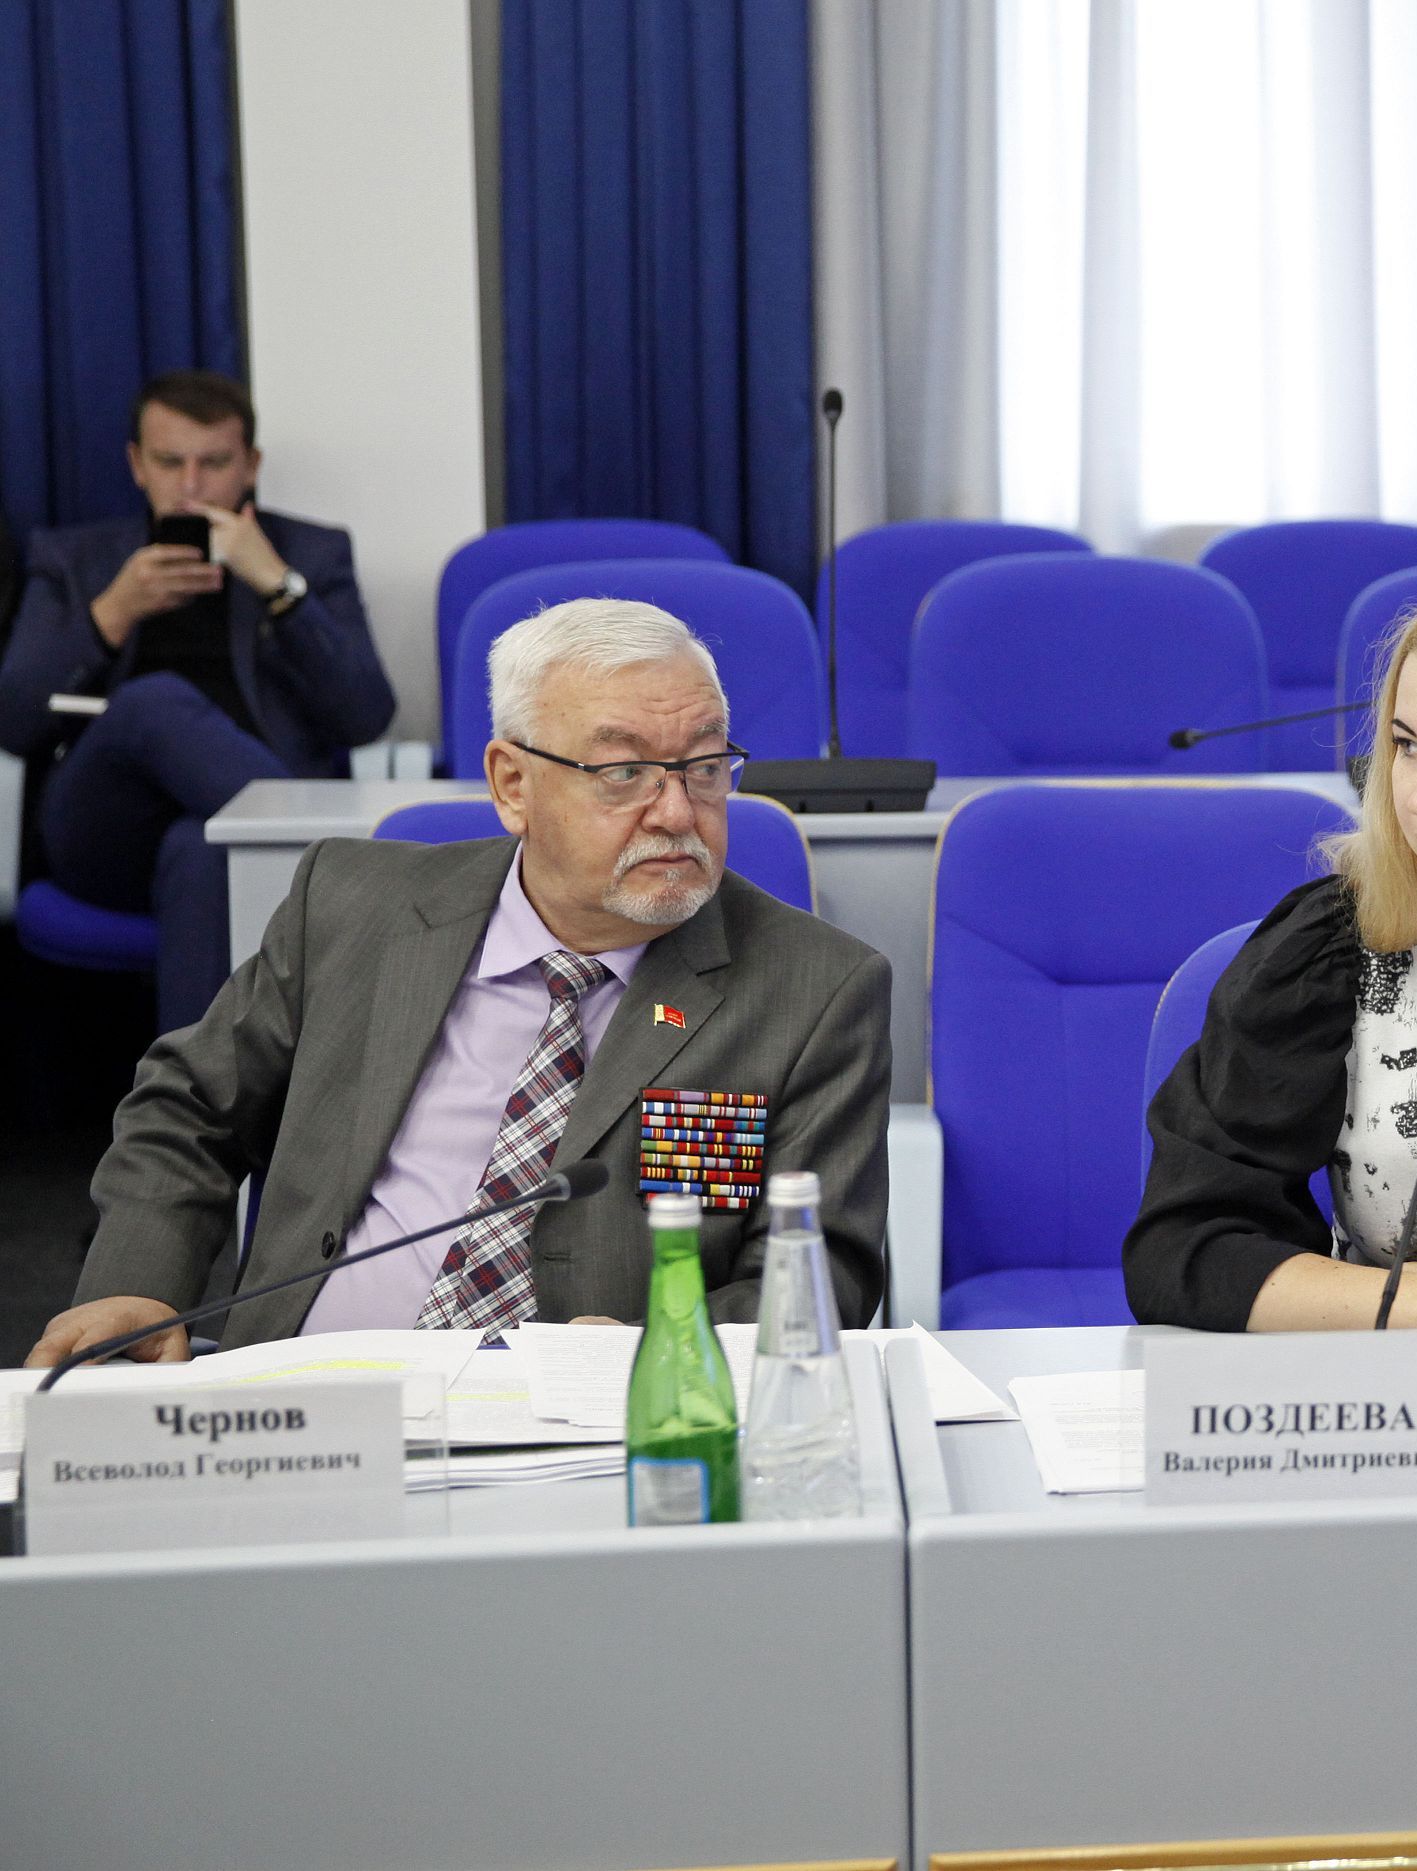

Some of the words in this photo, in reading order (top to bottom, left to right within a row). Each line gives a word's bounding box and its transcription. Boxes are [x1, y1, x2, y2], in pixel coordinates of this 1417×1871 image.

[154, 1404, 307, 1444] Чернов
[1191, 1402, 1416, 1438] ПОЗДЕЕВА
[54, 1460, 186, 1484] Всеволод
[195, 1452, 361, 1480] Георгиевич
[1163, 1451, 1273, 1476] Валерия
